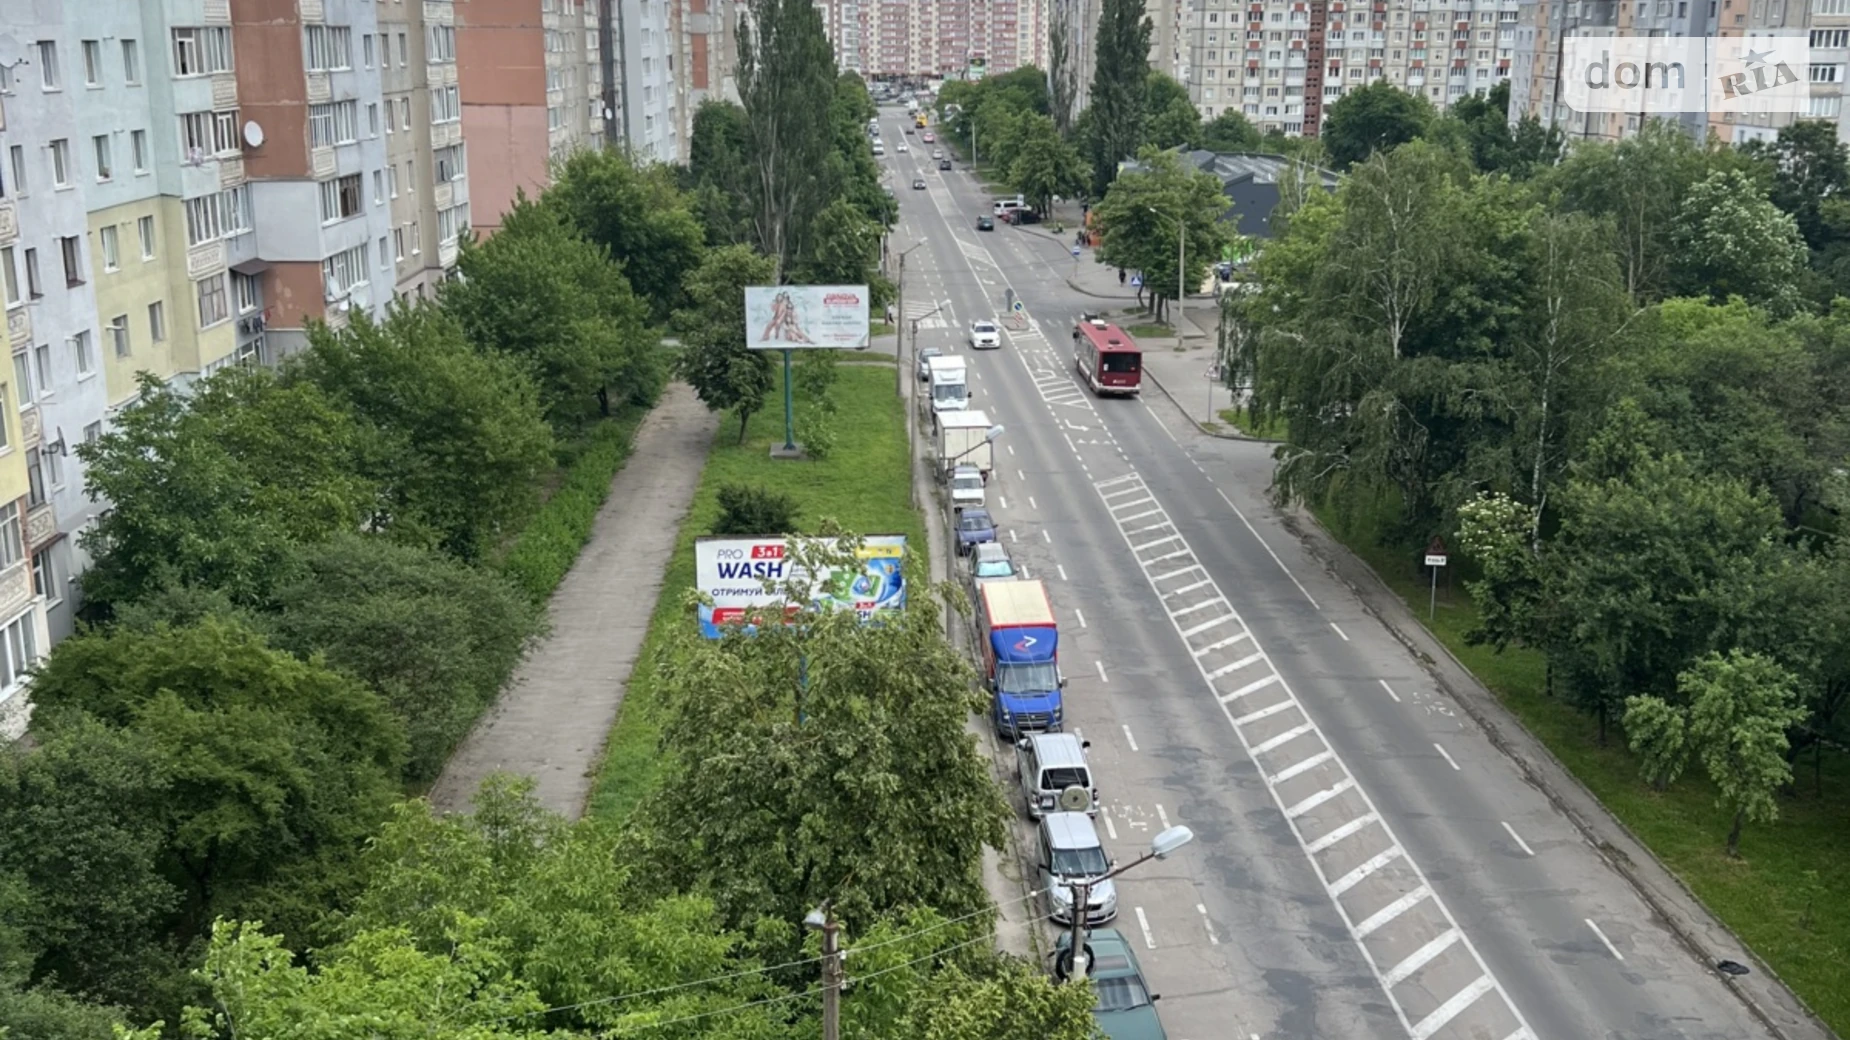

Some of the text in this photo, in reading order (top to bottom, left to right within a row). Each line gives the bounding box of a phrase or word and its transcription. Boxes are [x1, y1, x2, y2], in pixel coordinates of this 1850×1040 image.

[717, 549, 743, 560] PRO
[717, 562, 782, 579] WASH
[712, 588, 762, 597] ОТРИМУЙ
